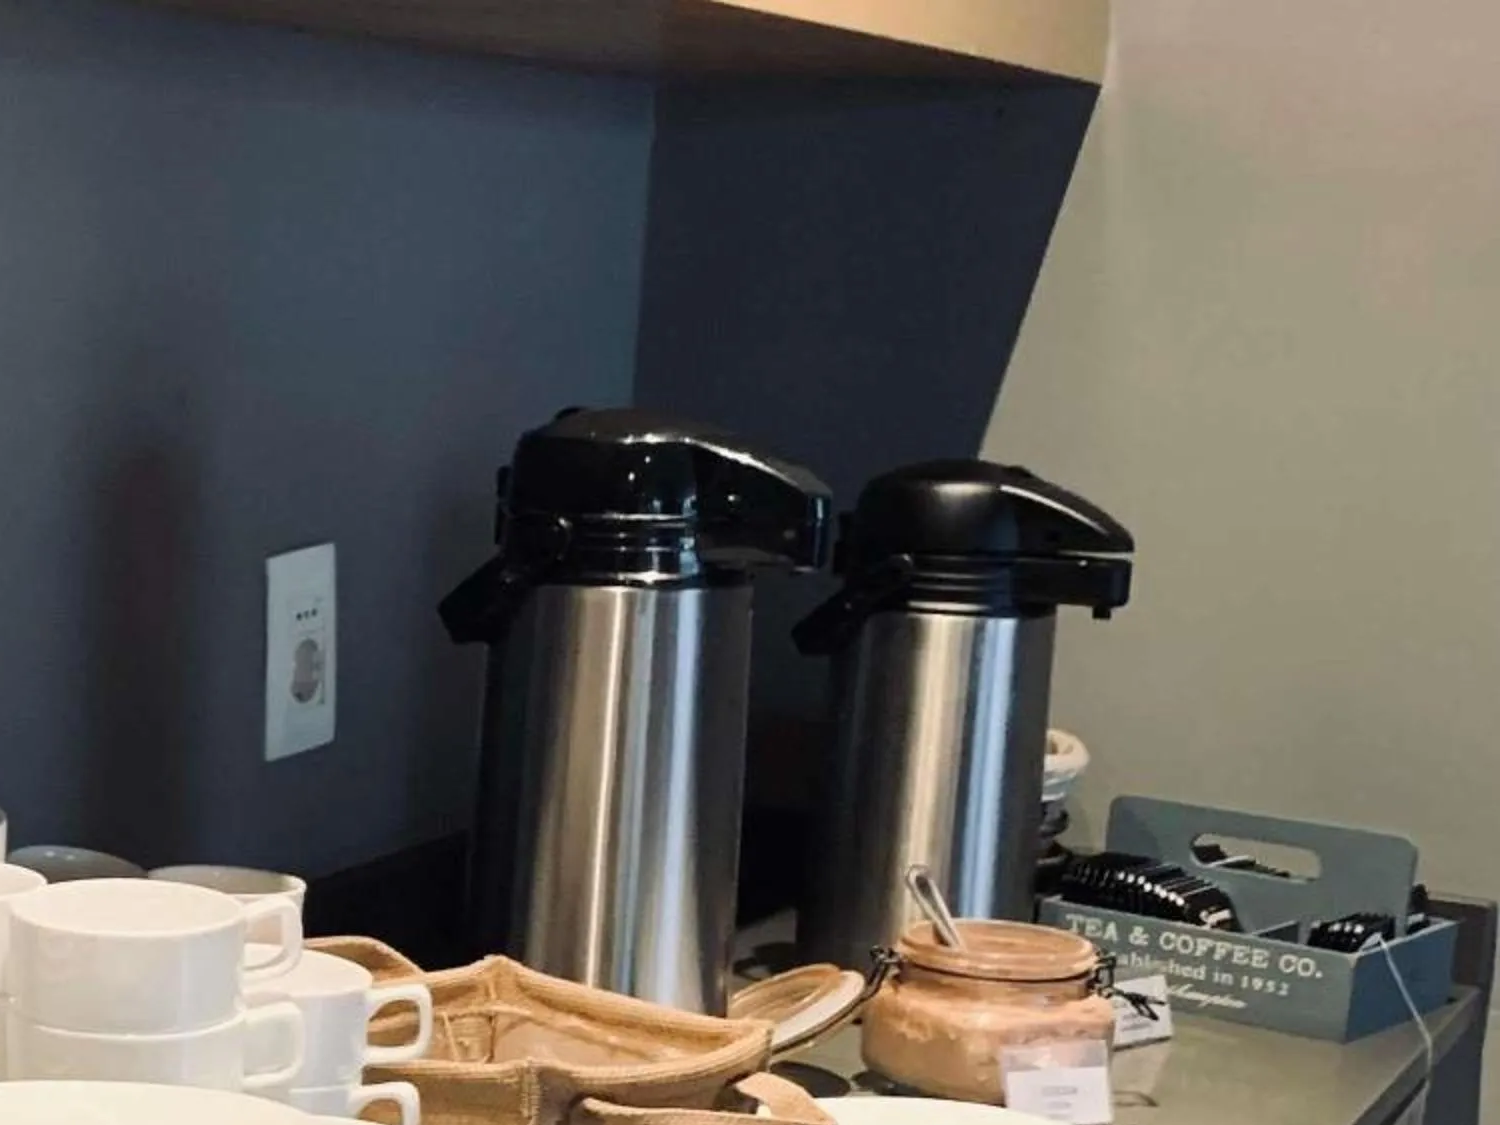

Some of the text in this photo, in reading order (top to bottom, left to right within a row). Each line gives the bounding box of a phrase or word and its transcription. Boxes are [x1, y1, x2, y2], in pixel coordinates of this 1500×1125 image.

[1065, 913, 1323, 979] TEA & COFFEE CO.
[1212, 966, 1234, 986] in
